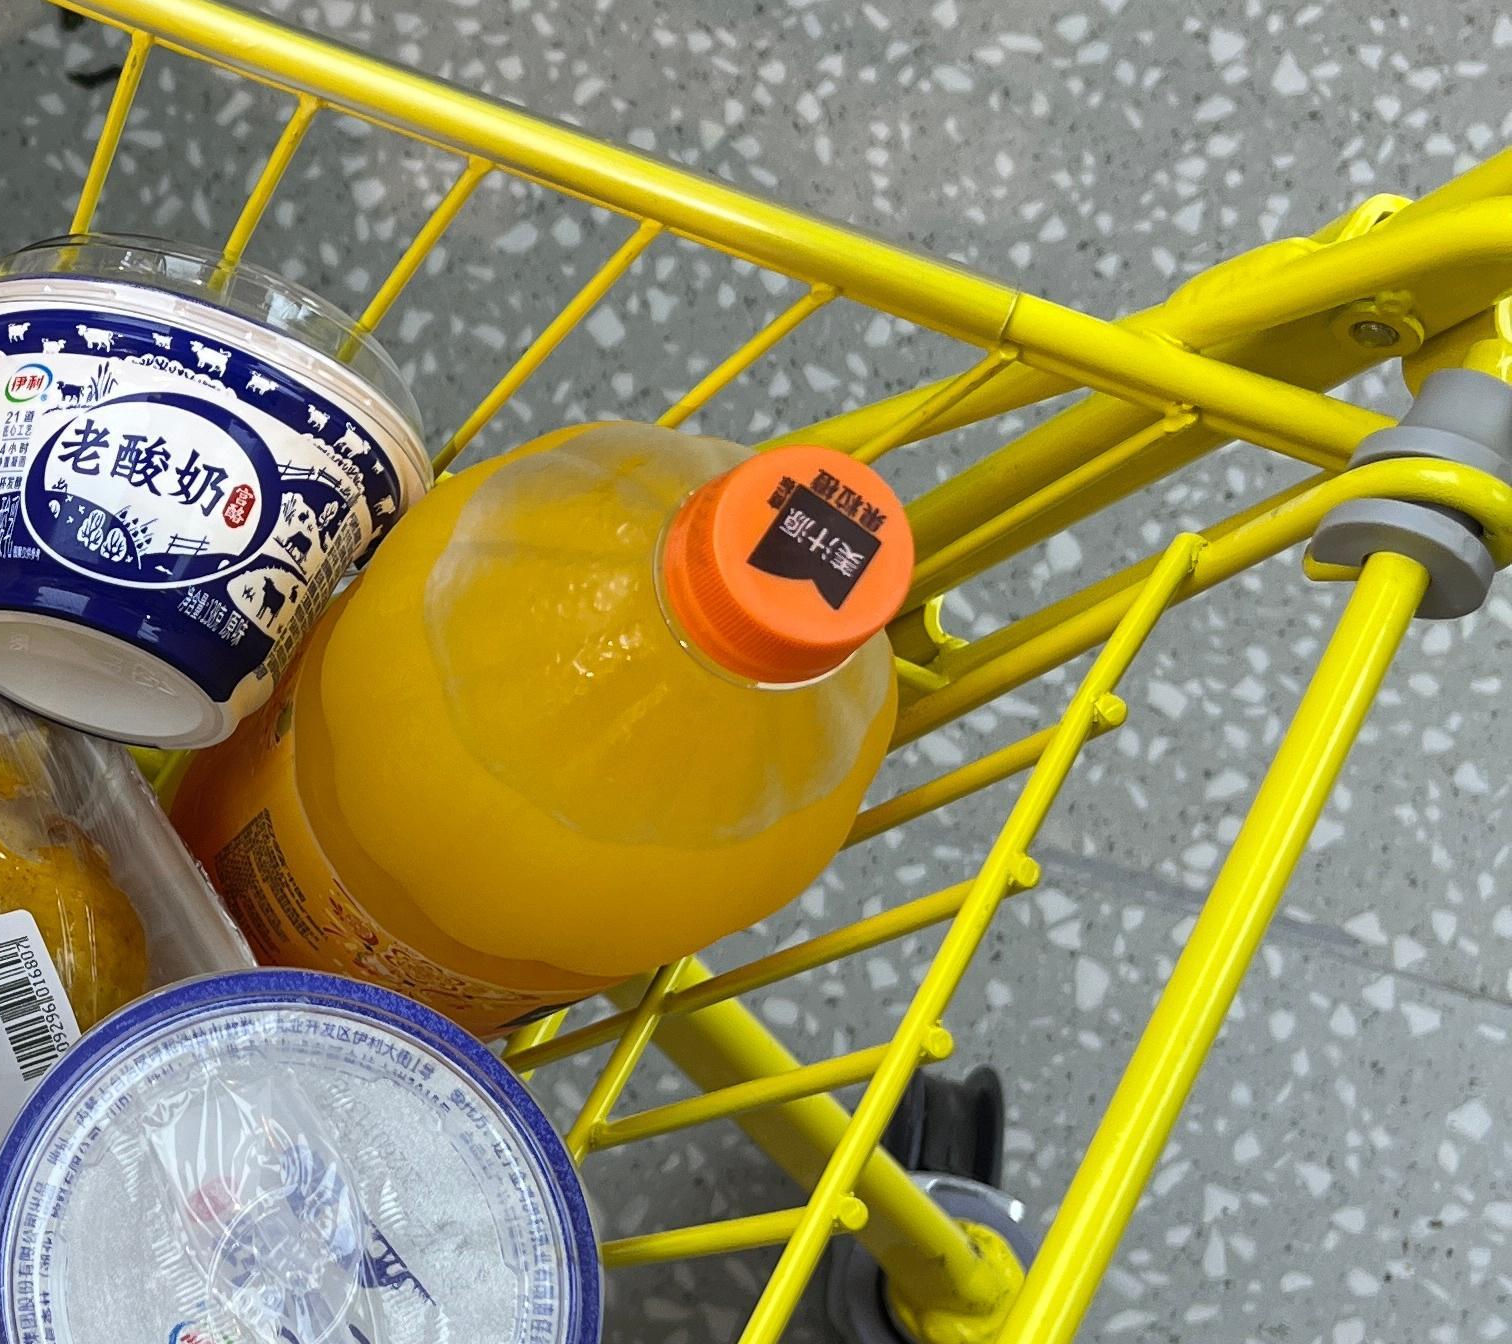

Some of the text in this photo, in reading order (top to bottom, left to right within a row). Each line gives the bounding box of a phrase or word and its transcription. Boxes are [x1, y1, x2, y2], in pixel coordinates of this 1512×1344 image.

[10, 374, 45, 393] 伊利
[59, 417, 229, 519] 老酸奶
[810, 468, 887, 533] 果粒橙
[779, 507, 865, 578] 美汁源
